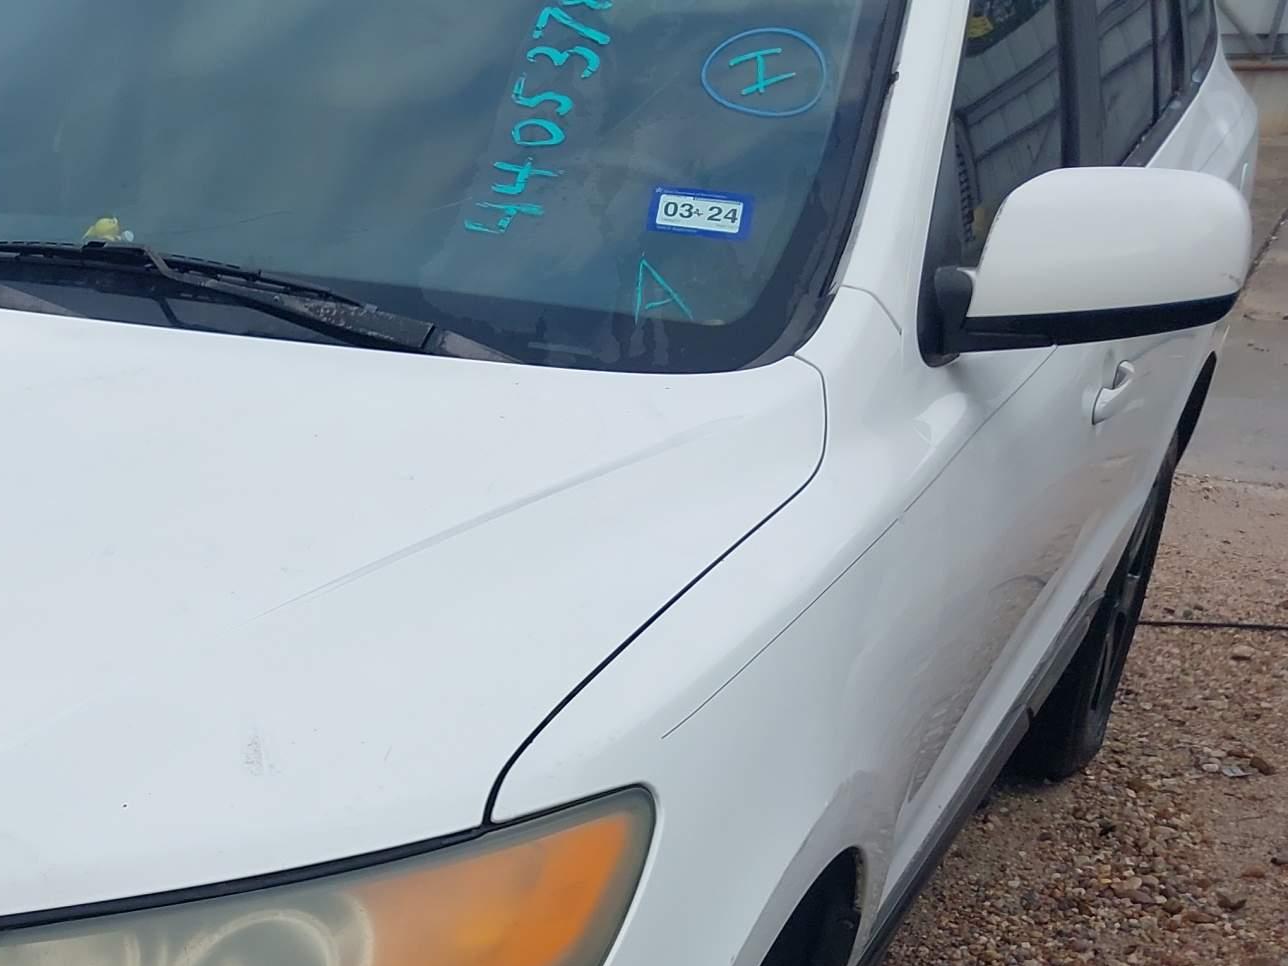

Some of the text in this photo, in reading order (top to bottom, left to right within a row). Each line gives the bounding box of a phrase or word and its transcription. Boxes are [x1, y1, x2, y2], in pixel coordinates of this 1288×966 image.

[464, 0, 613, 234] 440537
[707, 206, 738, 224] 24
[634, 257, 693, 325] A
